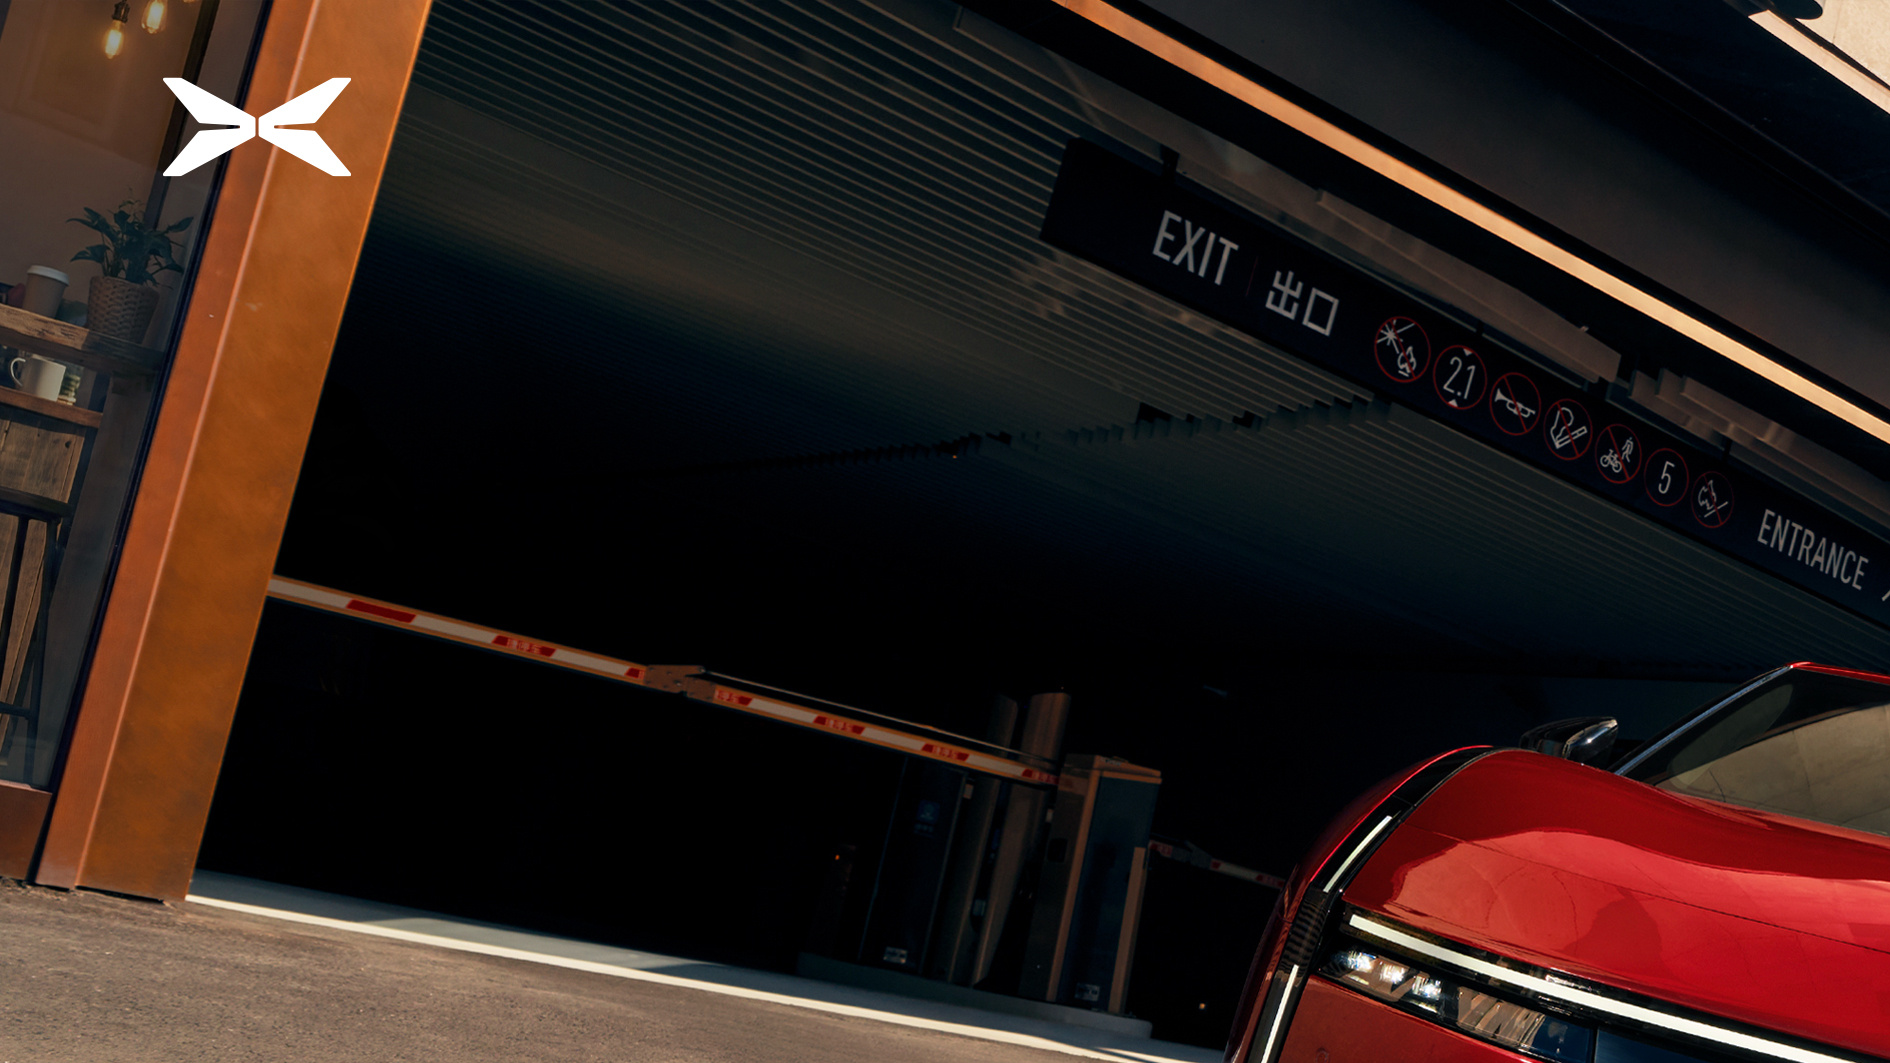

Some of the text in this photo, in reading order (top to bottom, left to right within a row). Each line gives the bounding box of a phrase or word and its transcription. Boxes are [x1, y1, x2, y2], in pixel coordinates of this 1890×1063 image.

[1153, 211, 1339, 336] EXIT 出口
[1443, 356, 1476, 400] 2.1
[1658, 460, 1676, 494] 5
[1757, 509, 1869, 590] ENTRANCE
